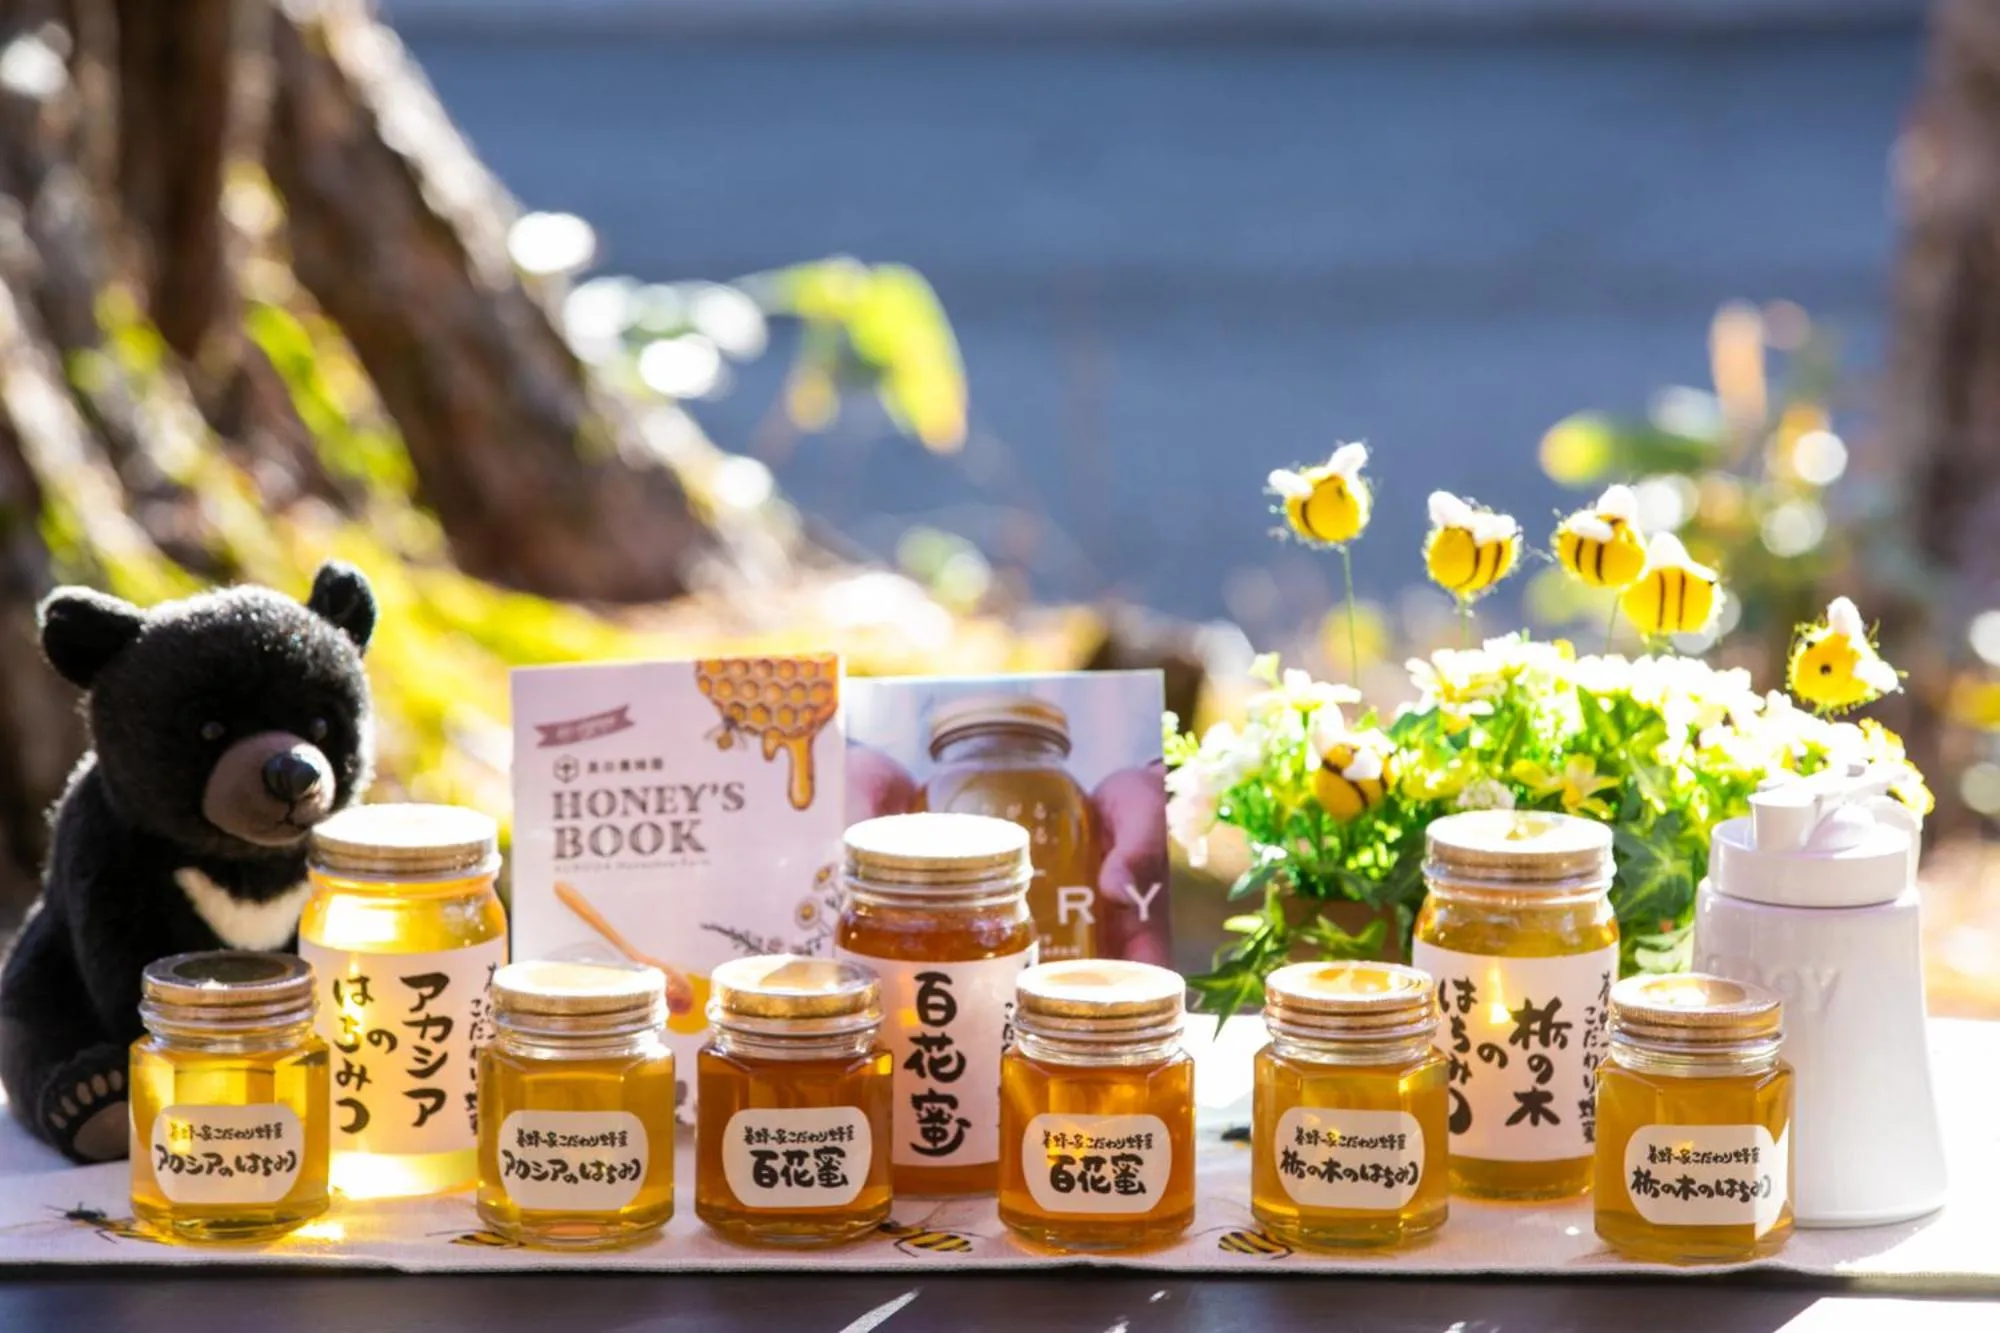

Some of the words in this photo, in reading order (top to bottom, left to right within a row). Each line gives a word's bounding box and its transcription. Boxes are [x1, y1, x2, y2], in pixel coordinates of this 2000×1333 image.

[552, 781, 746, 820] HONEY'S
[552, 818, 707, 861] BOOK
[399, 972, 454, 1127] アカシア
[903, 971, 973, 1157] 百花蜜
[1505, 996, 1573, 1127] 栃の木
[154, 1143, 298, 1177] アカシアのはちみつ
[501, 1149, 642, 1184] アカシアのはちみつ
[749, 1145, 849, 1189] 百花蜜
[1046, 1152, 1147, 1195] 百花蜜
